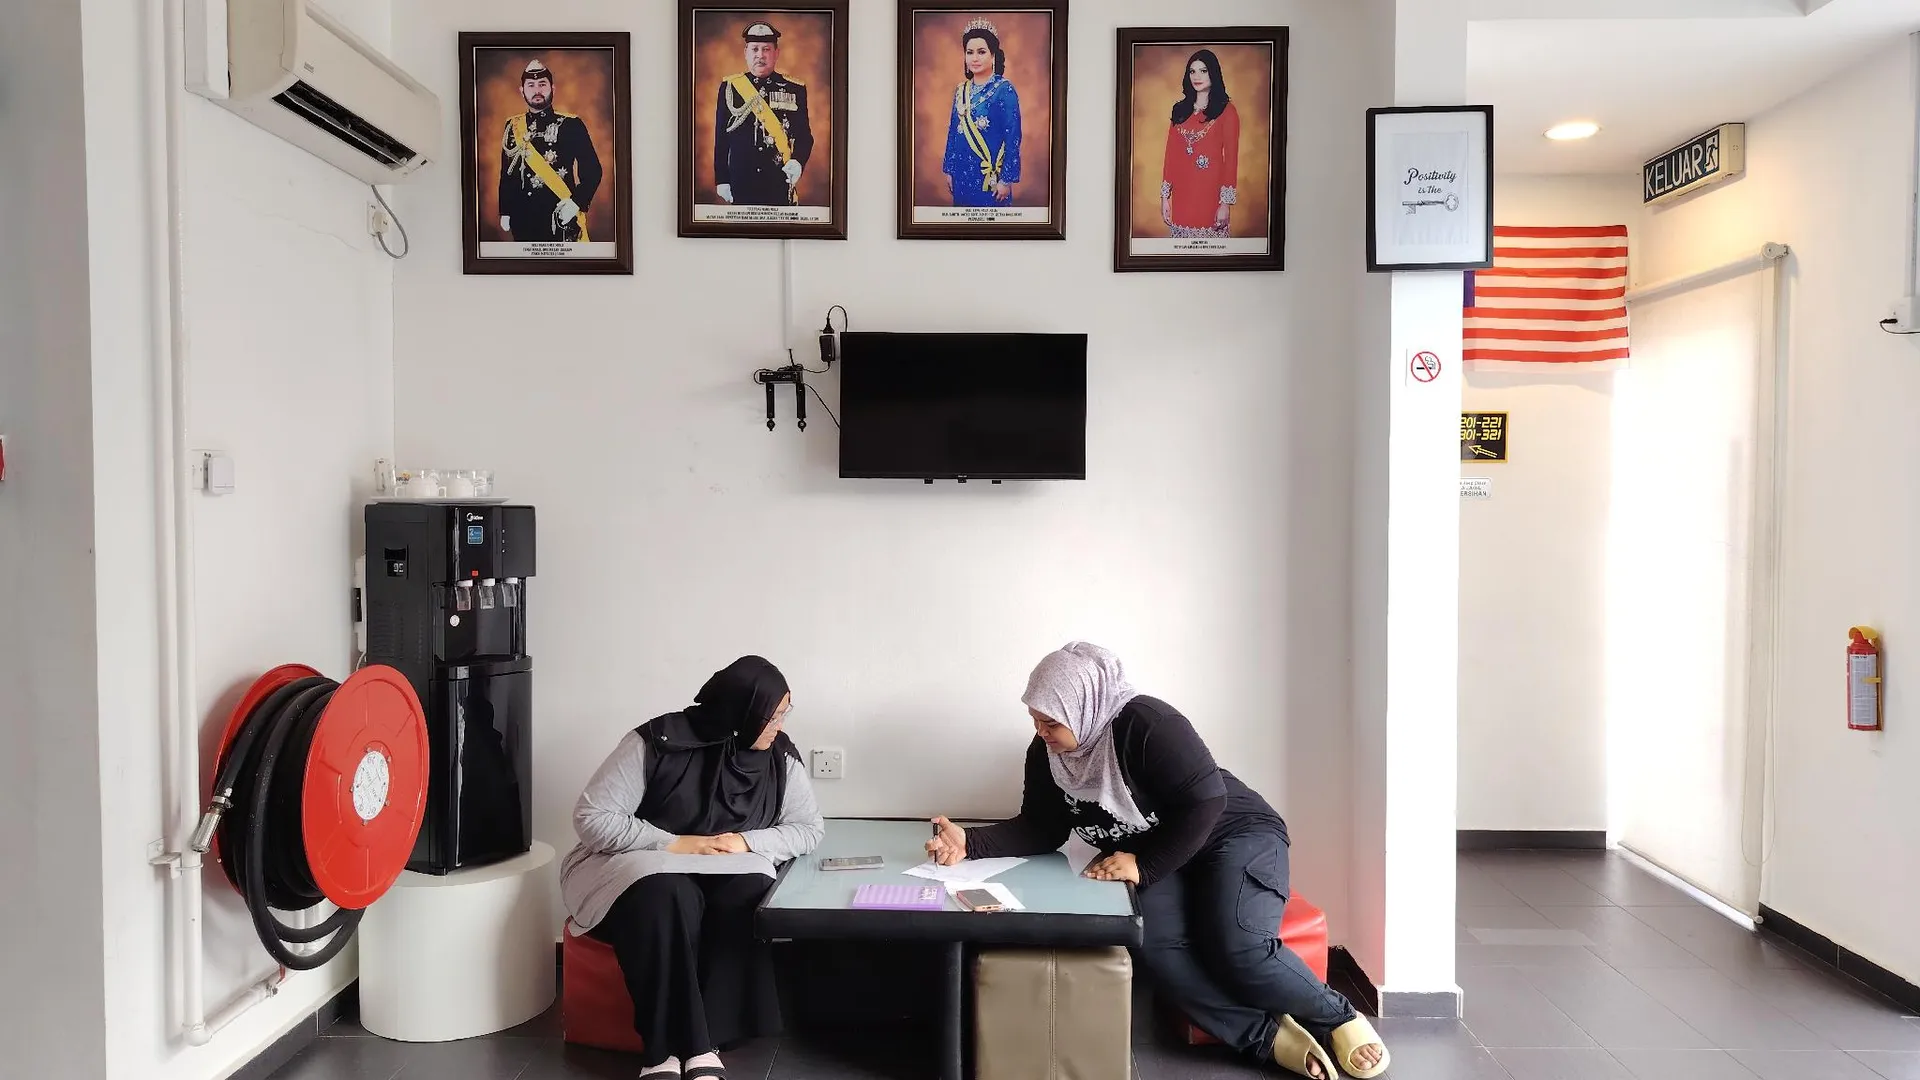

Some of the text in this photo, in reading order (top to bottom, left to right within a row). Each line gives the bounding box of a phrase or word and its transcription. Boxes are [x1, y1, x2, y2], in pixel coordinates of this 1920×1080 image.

[1403, 167, 1458, 186] Positivity
[1645, 143, 1703, 199] KELUAR
[1460, 416, 1502, 428] 201-221
[1460, 429, 1502, 441] 301-321
